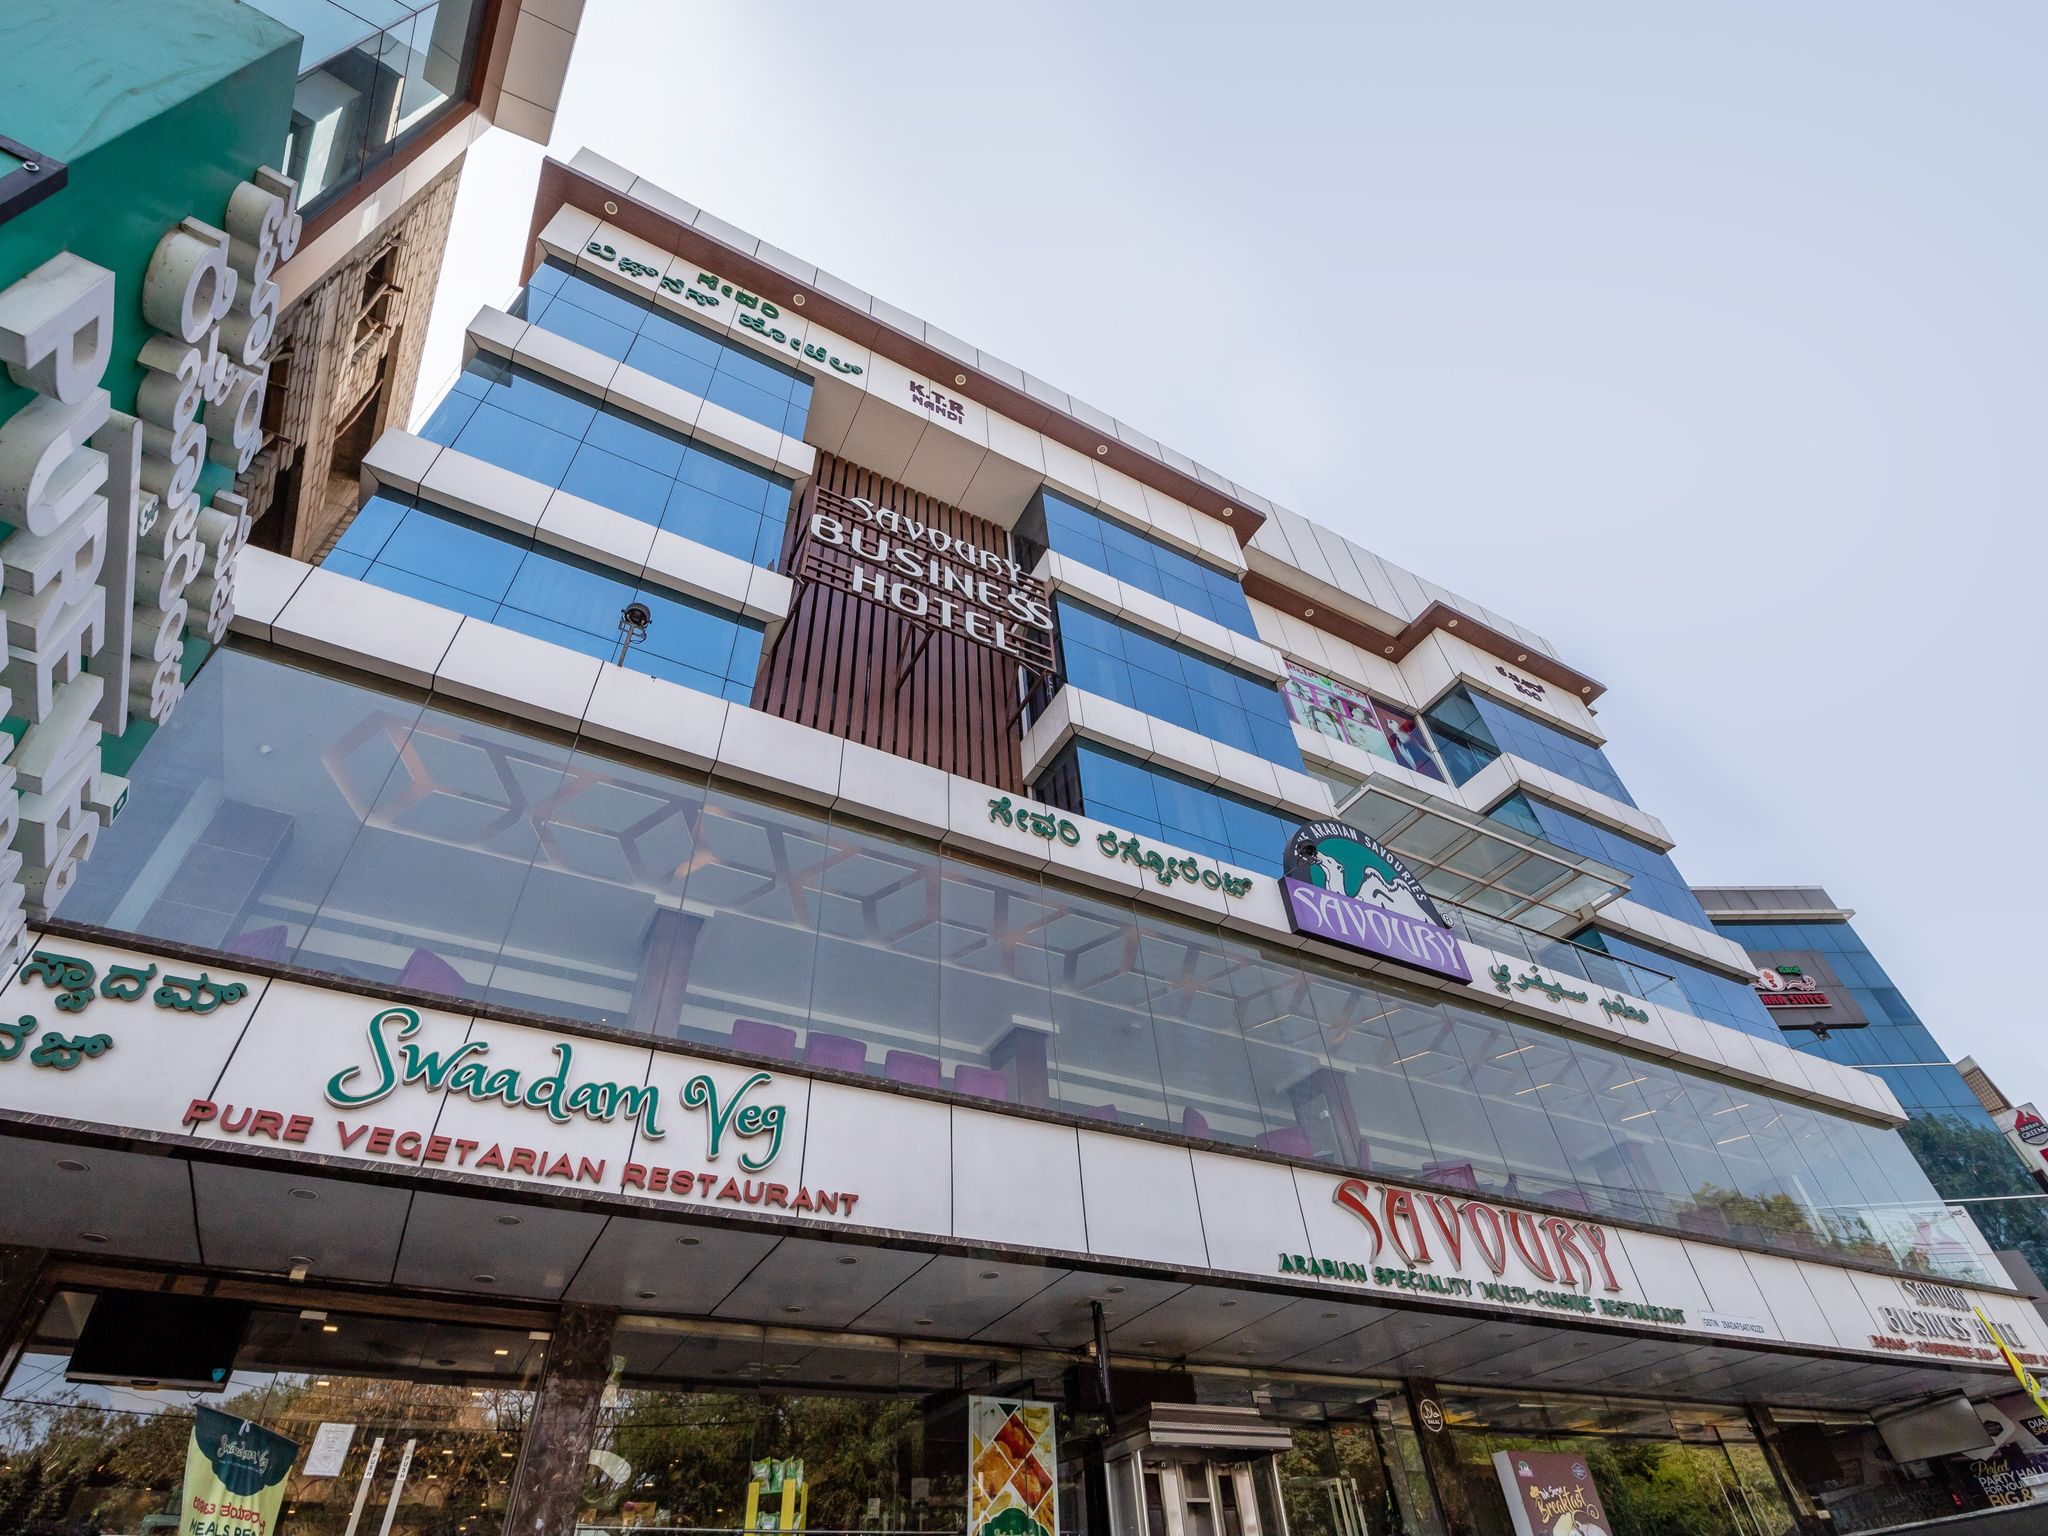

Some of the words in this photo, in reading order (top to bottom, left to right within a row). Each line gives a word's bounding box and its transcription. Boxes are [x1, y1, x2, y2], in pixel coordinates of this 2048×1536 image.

[910, 381, 965, 416] K.T.R
[912, 394, 963, 424] NANDI
[0, 252, 116, 722] PURE
[810, 513, 1053, 630] BUSINESS
[850, 497, 1021, 584] SAVOURY
[852, 565, 1020, 655] HOTEL
[10, 672, 104, 922] VEG
[1309, 822, 1359, 841] ARABIAN
[1364, 836, 1427, 901] SAVOURIES
[1294, 886, 1462, 970] SAVOURY
[324, 1006, 666, 1140] Swaadam
[679, 1071, 787, 1174] Veg
[182, 1099, 313, 1143] PURE
[337, 1120, 606, 1183] VEGETARIAN
[621, 1162, 859, 1217] RESTAURANT
[1332, 1178, 1623, 1293] SAVOURY
[1278, 1252, 1368, 1283] ARABIAN
[1371, 1266, 1473, 1297] SPECIALITY
[1594, 1298, 1686, 1325] RESTAURANT
[1878, 1306, 1972, 1342] BUSINESS
[1902, 1280, 1972, 1312] SAVOURY
[366, 1453, 377, 1477] PUSH
[400, 1456, 410, 1479] PUSH
[1979, 1471, 2015, 1487] PARTY
[1984, 1486, 2003, 1495] FOR
[189, 1518, 230, 1536] MEALS
[1536, 1484, 1587, 1524] Breakfast
